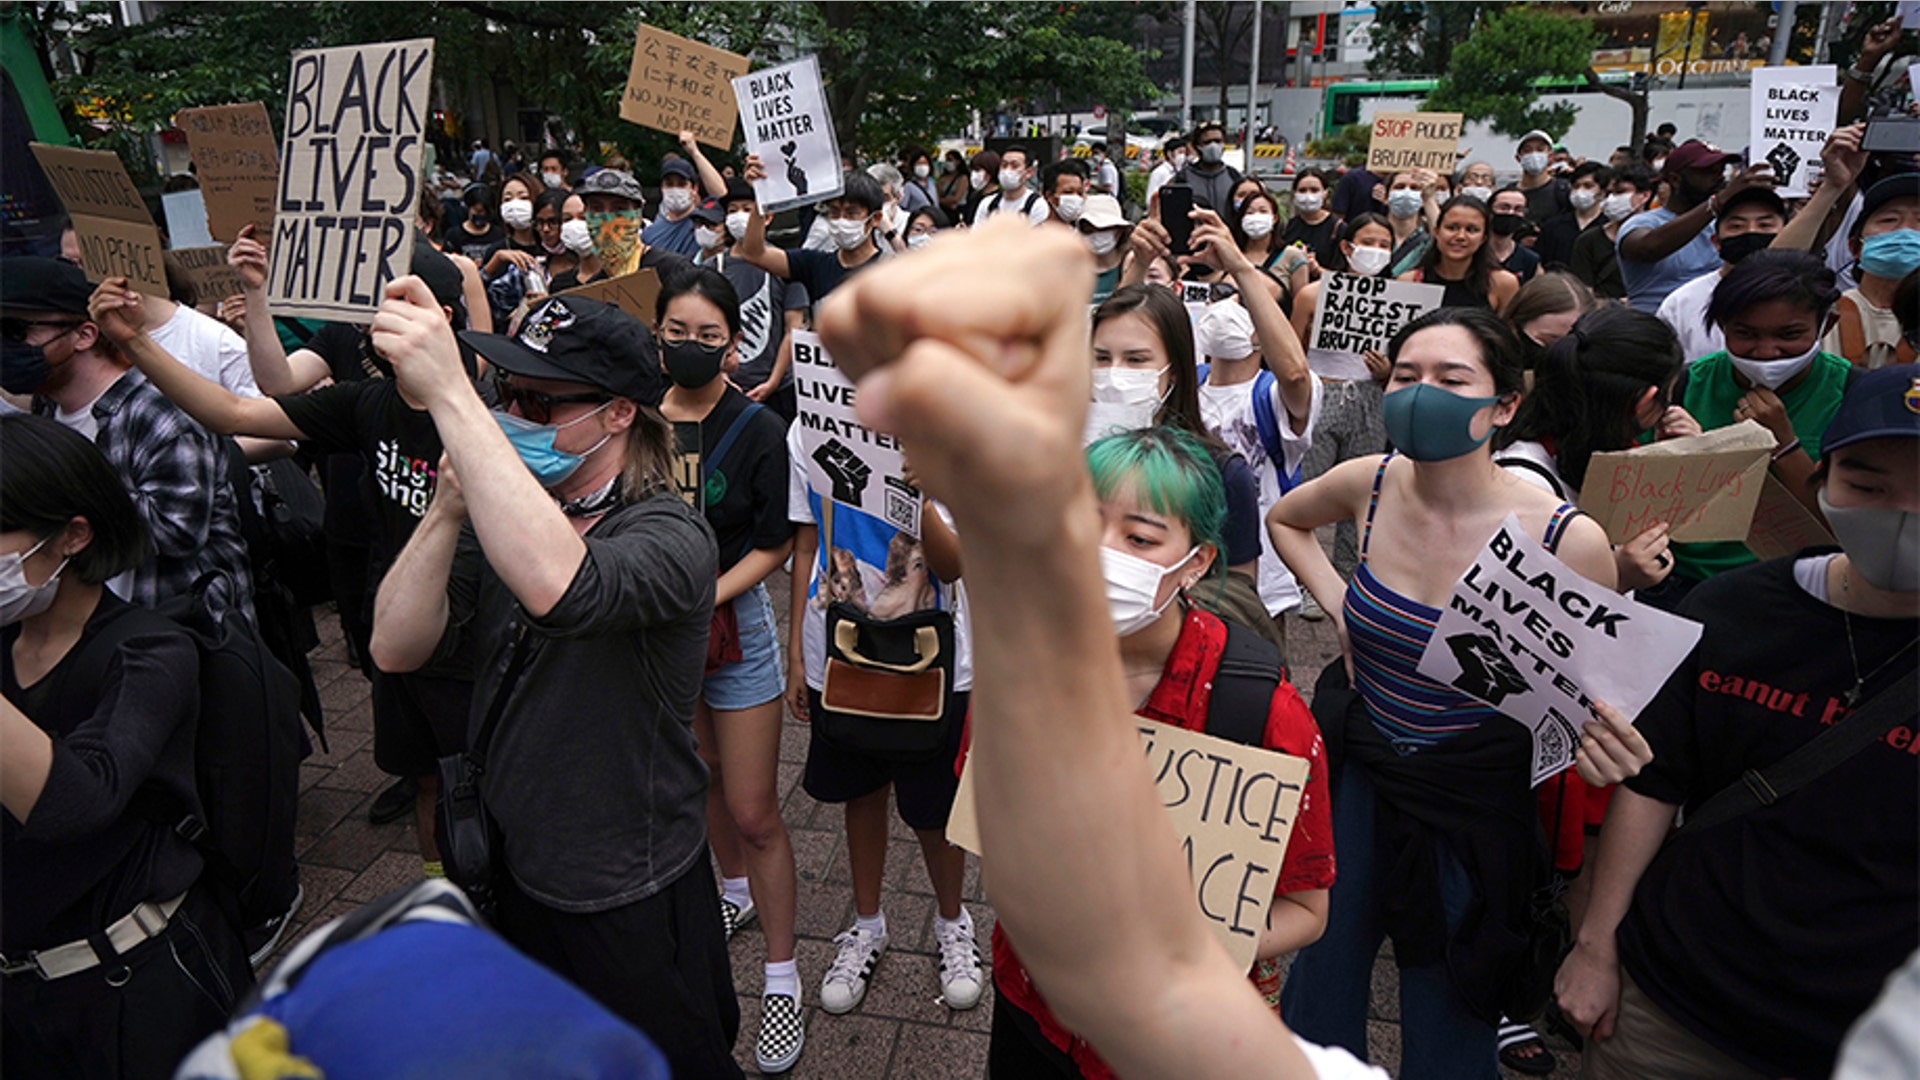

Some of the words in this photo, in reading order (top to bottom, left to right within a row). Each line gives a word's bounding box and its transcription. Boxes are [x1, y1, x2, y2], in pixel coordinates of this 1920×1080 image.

[287, 48, 429, 139] BLACK
[750, 71, 794, 99] BLACK
[1768, 88, 1819, 102] BLACK
[629, 86, 652, 104] NO
[653, 95, 712, 121] JUSTICE
[754, 95, 793, 121] LIVES
[1766, 108, 1810, 122] LIVES
[757, 114, 814, 143] MATTER
[1375, 119, 1413, 138] STOP
[1415, 121, 1458, 140] POLICE
[1763, 127, 1828, 142] MATTER
[1371, 149, 1454, 169] BRUTALITY!
[281, 135, 418, 215] LIVES
[80, 235, 107, 275] NO
[105, 236, 160, 284] PEACE
[267, 216, 405, 307] MATTER
[1328, 272, 1386, 296] STOP
[1325, 291, 1423, 321] RACIST
[1321, 312, 1399, 338] POLICE
[797, 377, 856, 407] LIVE
[1609, 463, 1688, 503] Black
[1489, 528, 1630, 639] BLACK
[1463, 563, 1575, 659] LIVES
[1698, 669, 1811, 718] eanut
